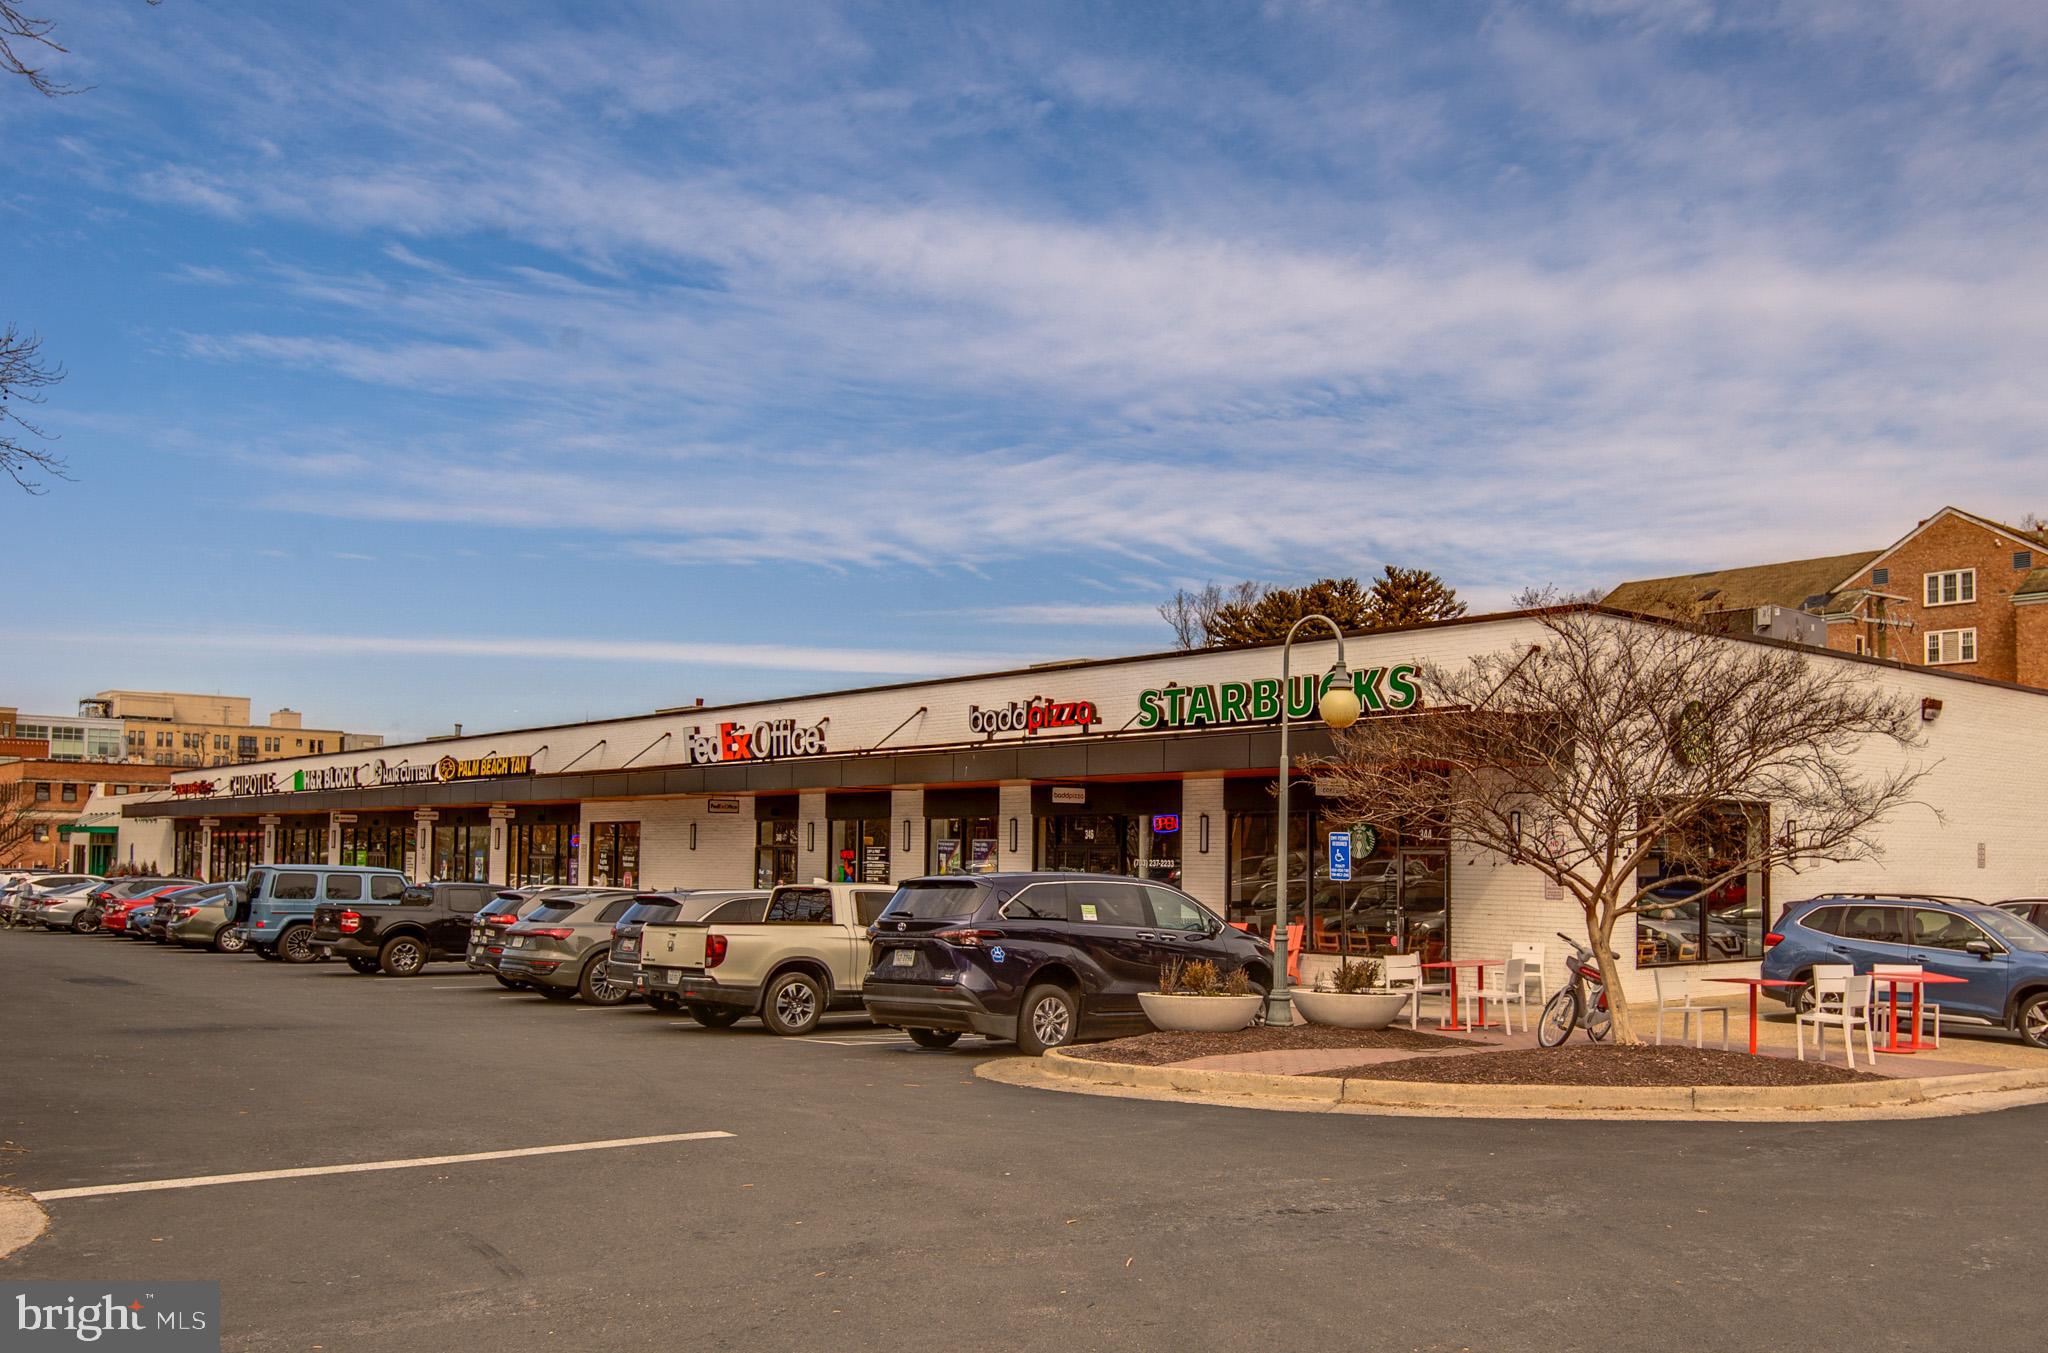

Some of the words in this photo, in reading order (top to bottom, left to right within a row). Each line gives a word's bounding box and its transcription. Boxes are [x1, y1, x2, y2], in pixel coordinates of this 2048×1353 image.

[383, 768, 399, 783] HAIR
[400, 764, 433, 782] CUTTERY
[457, 760, 479, 777] PALM
[480, 757, 508, 775] BEACH
[511, 756, 528, 773] TAN
[230, 773, 273, 795] CHIPOTLE
[305, 770, 322, 790] H&R
[324, 766, 356, 788] BLOCK
[1149, 859, 1175, 868] 237-2233
